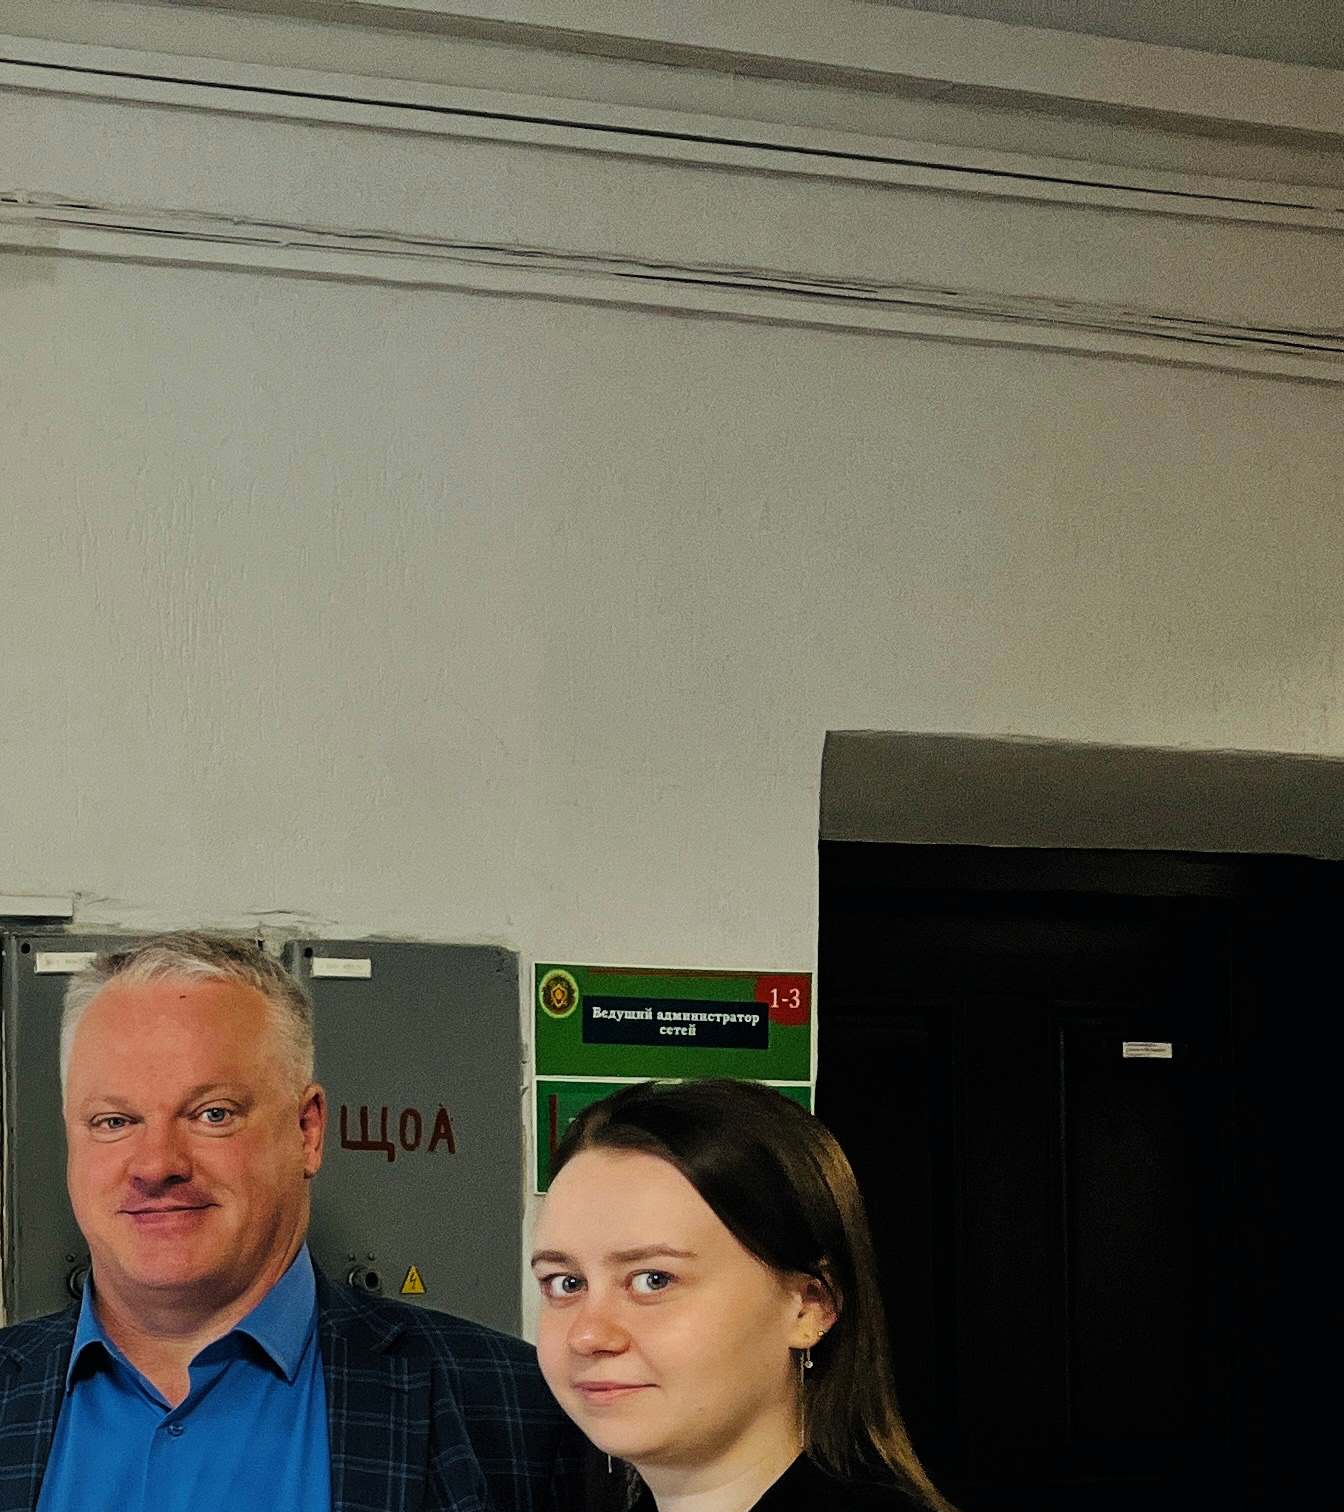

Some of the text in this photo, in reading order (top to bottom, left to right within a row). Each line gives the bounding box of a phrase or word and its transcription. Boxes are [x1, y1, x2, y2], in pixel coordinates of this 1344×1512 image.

[769, 988, 801, 1009] 1-3
[656, 1009, 760, 1026] администратор
[659, 1023, 696, 1036] сетей
